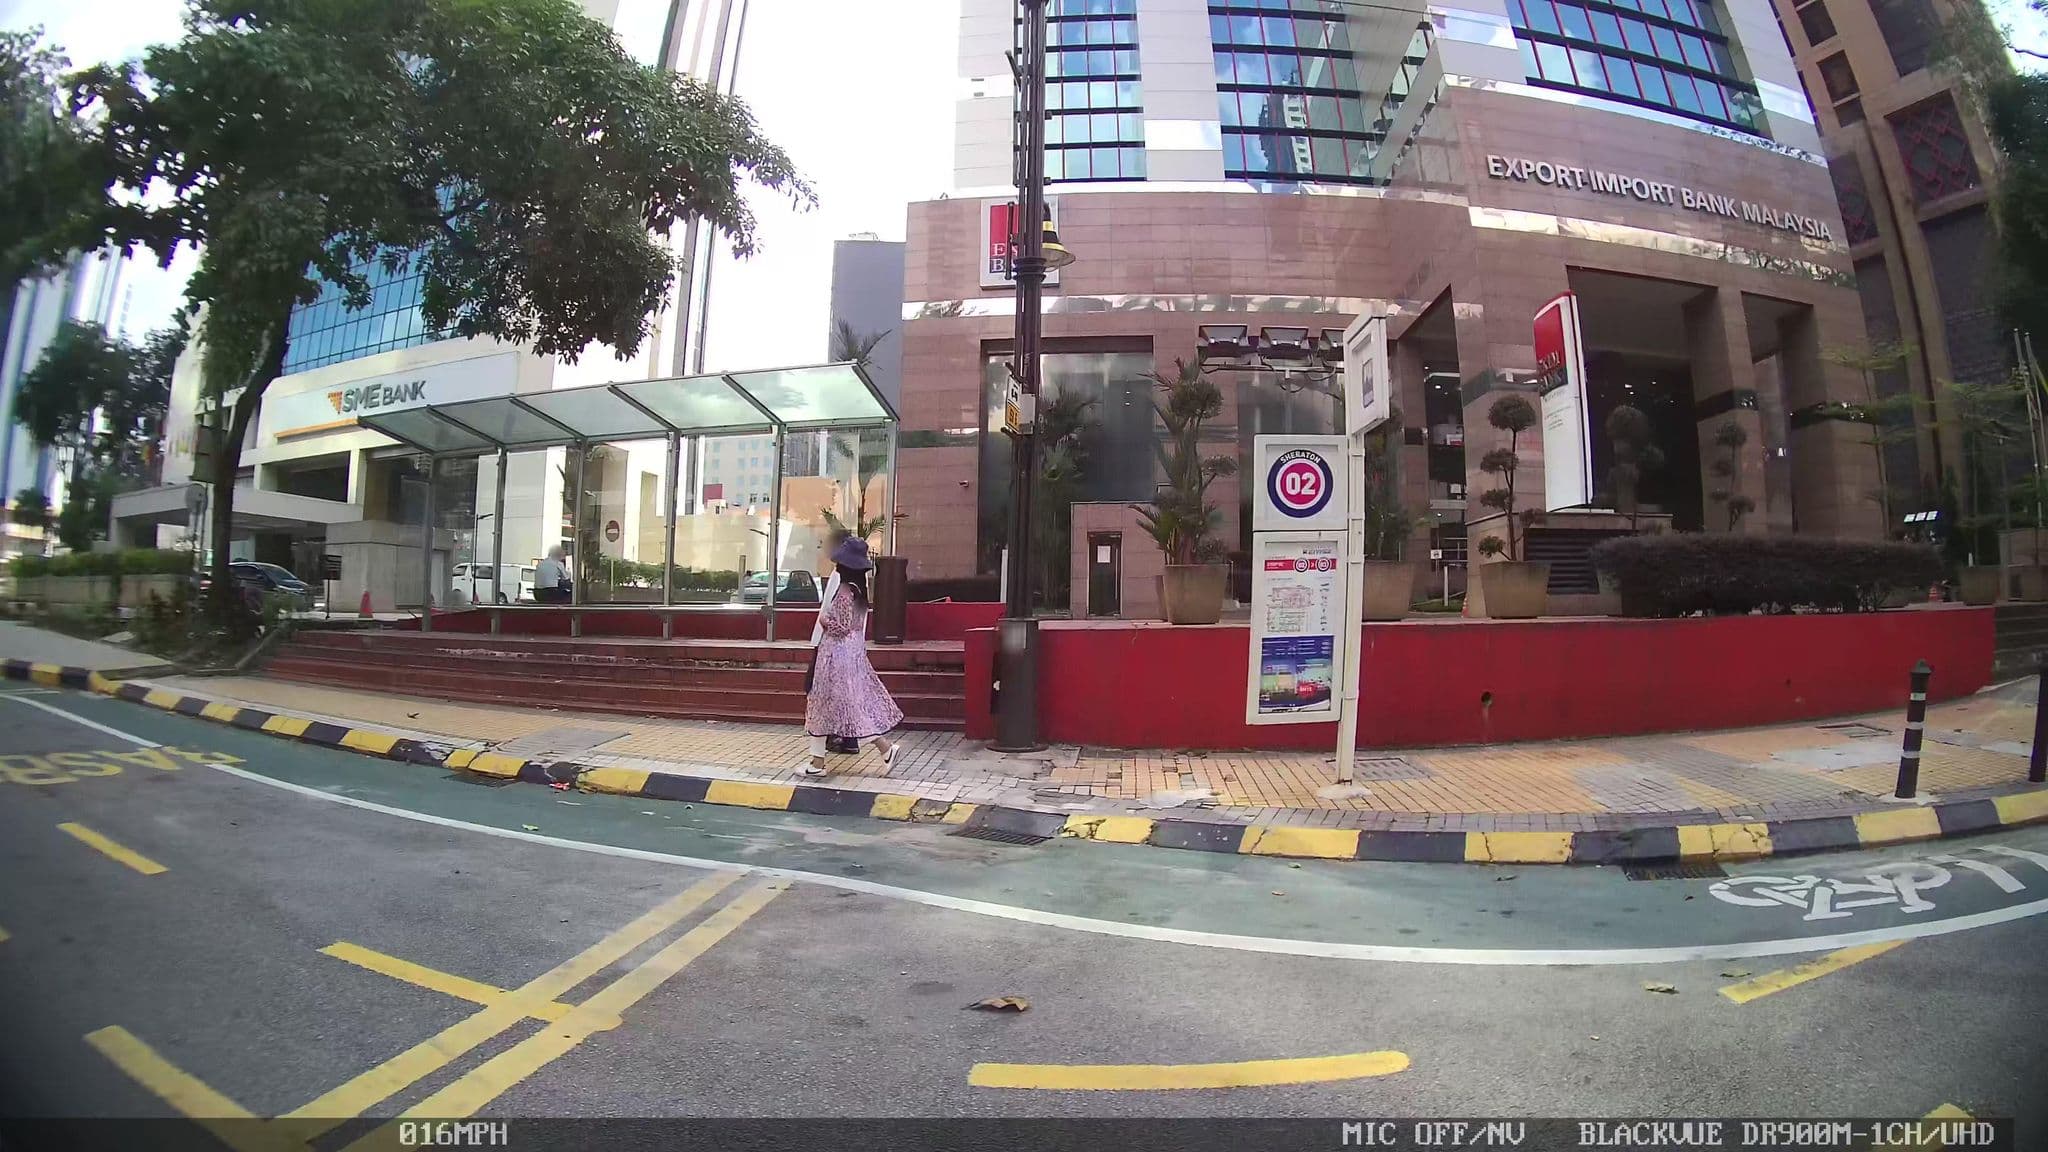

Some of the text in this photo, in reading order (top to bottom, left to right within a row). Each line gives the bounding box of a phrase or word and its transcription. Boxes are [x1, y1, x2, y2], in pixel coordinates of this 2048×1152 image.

[1682, 186, 1738, 219] BANK
[1741, 201, 1833, 241] MALAYSIA
[343, 381, 426, 412] SME BANK
[1280, 451, 1321, 463] SHERATON
[1286, 472, 1315, 495] 02
